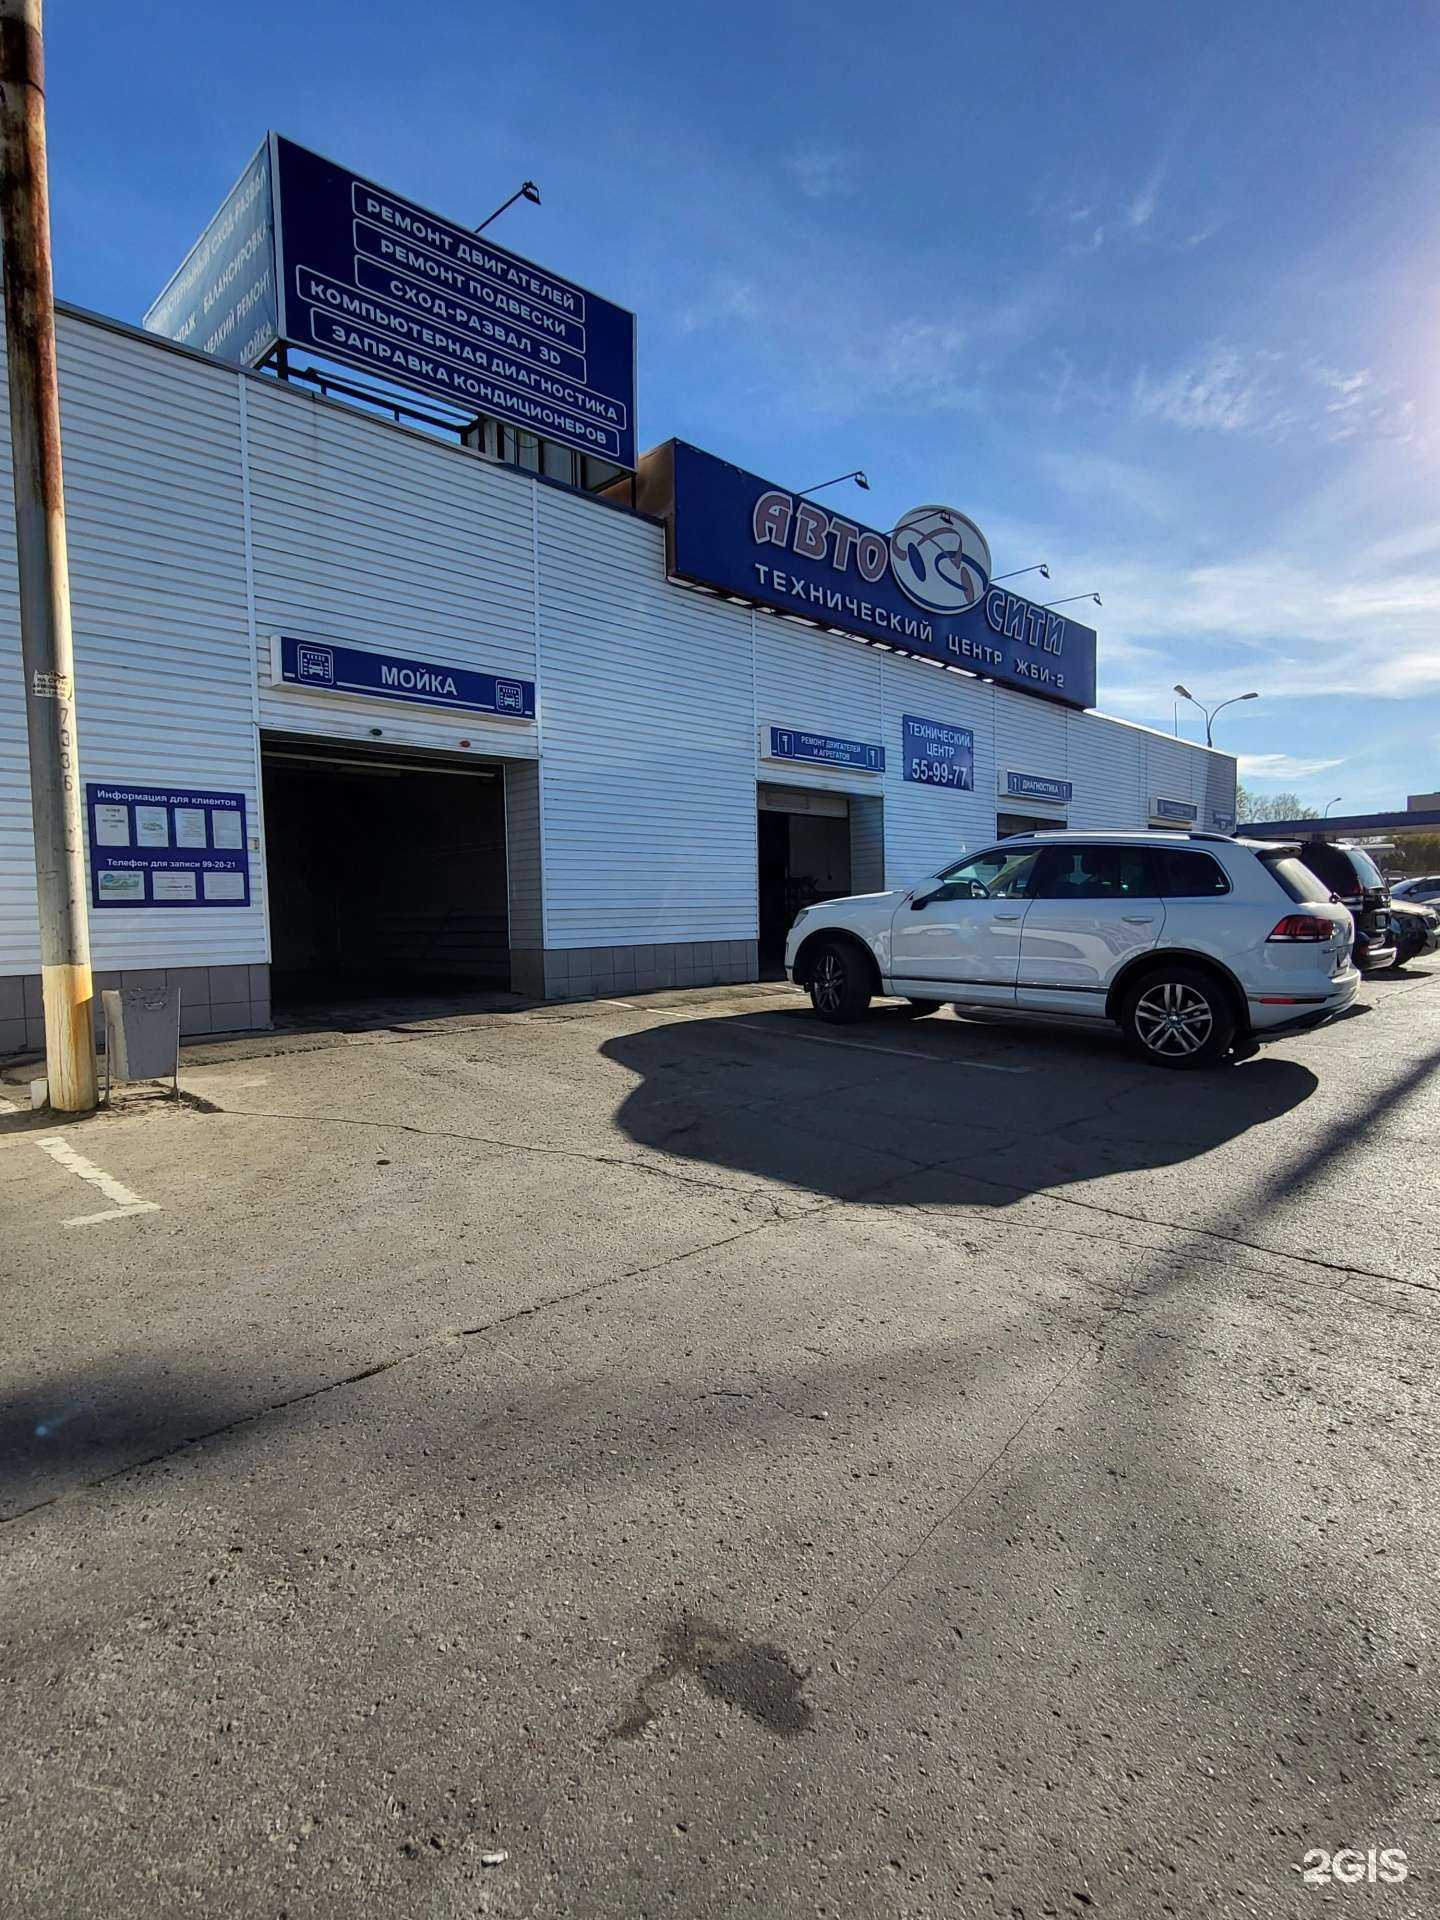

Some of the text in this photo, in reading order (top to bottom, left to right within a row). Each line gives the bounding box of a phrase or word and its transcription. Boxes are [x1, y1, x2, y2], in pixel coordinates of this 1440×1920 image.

[367, 198, 576, 311] РЕМОНТ ДВИГАТЕЛЕЙ
[236, 269, 271, 325] РЕМОНТ
[380, 239, 567, 337] РЕМОНТ ПОДВЕСКИ
[390, 279, 561, 367] СХОД-РАЗВАЛ 3D
[310, 281, 618, 422] КОМПЬЮТЕРНАЯ ДИАГНОСТИКА
[331, 324, 607, 445] ЗАПРАВКА КОНДИЦИОНЕРОВ
[753, 490, 1066, 657] АВТО СИТИ
[755, 562, 1065, 689] ТЕХНИЧЕСКИЙ ЦЕНТР ЖБИ-2
[381, 664, 458, 696] МОЙКА
[801, 735, 861, 754] РЕМОНТ ДВИГАТЕЛЕЙ
[907, 721, 971, 747] ТЕХНИЧЕСКИЙ
[926, 741, 955, 758] ЦЕНТР
[911, 758, 968, 786] 55-99-77
[1022, 778, 1060, 794] ДИАГНОСТИКА
[96, 789, 238, 808] Информация для клиентов
[106, 858, 237, 869] Телефон для записи 99-20-21
